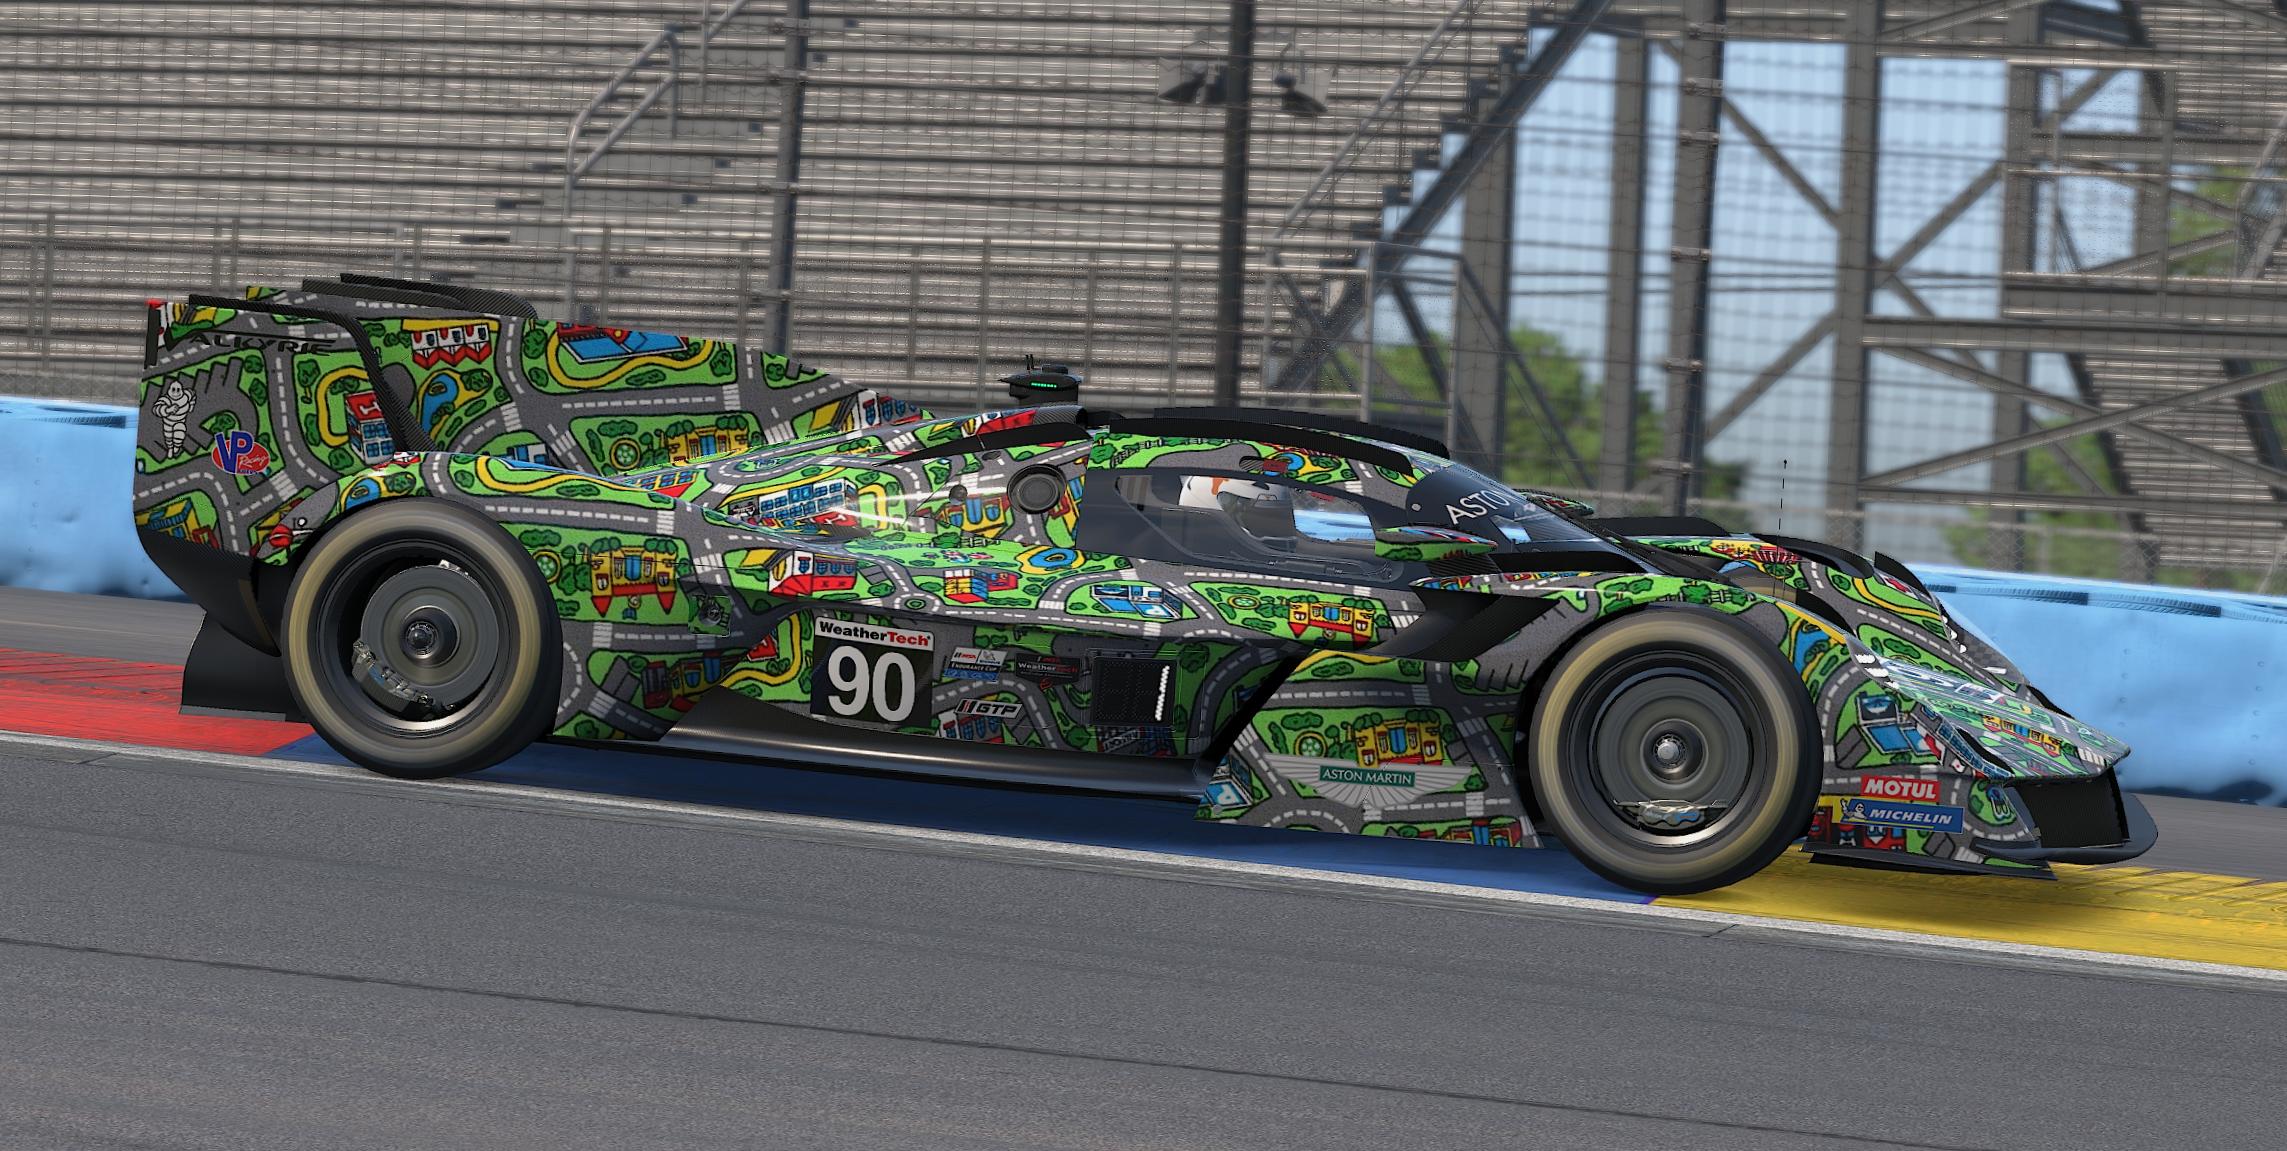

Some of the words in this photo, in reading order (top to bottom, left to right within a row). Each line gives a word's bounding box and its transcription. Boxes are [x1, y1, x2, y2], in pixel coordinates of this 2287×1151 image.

[165, 328, 336, 356] VALKYRIE
[215, 431, 254, 474] VP
[820, 621, 928, 646] WeatherTech
[828, 645, 915, 721] 90
[976, 702, 1017, 716] GTP
[1322, 769, 1362, 781] ASTON
[1365, 773, 1412, 785] MARTIN
[1864, 779, 1936, 798] MOTUL
[1869, 809, 1952, 824] MICHELIN
